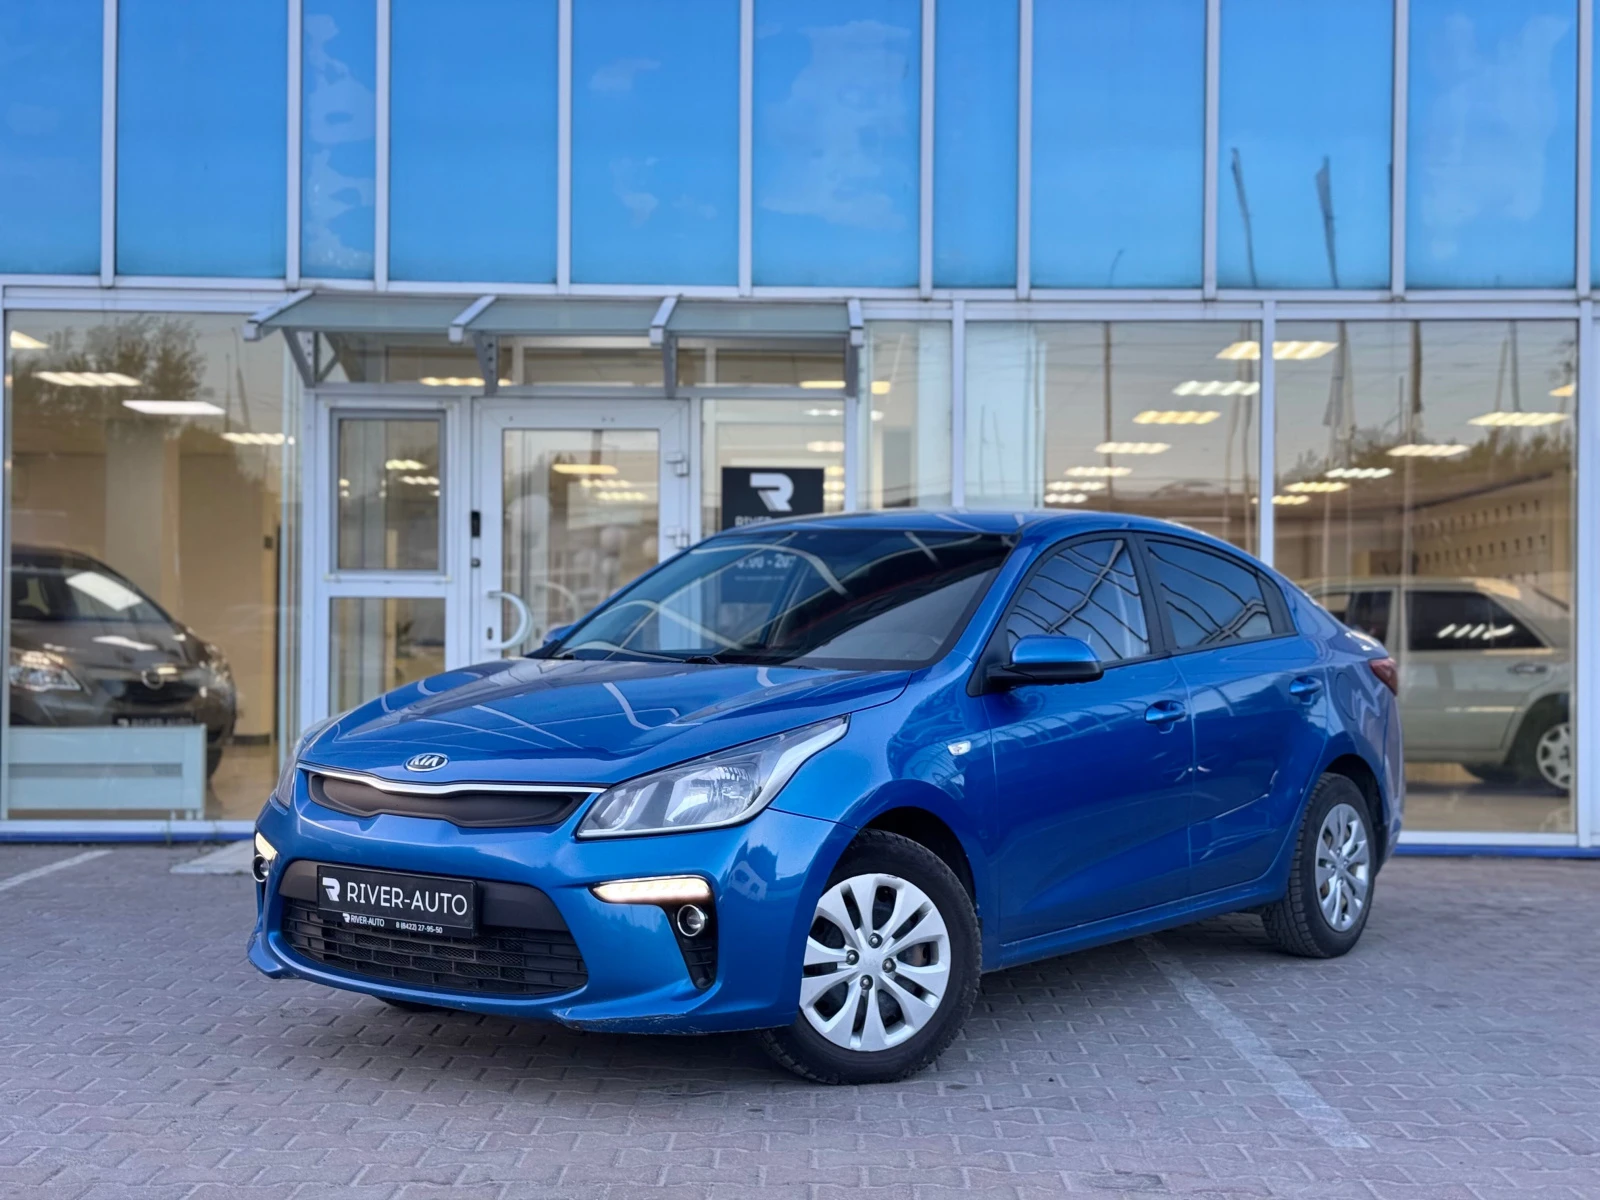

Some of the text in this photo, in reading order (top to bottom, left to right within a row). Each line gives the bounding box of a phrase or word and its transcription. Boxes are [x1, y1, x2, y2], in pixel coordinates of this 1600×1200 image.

[408, 754, 441, 767] KIA
[347, 881, 468, 916] RIVER-AUTO
[351, 914, 385, 927] RIVER-AUTO
